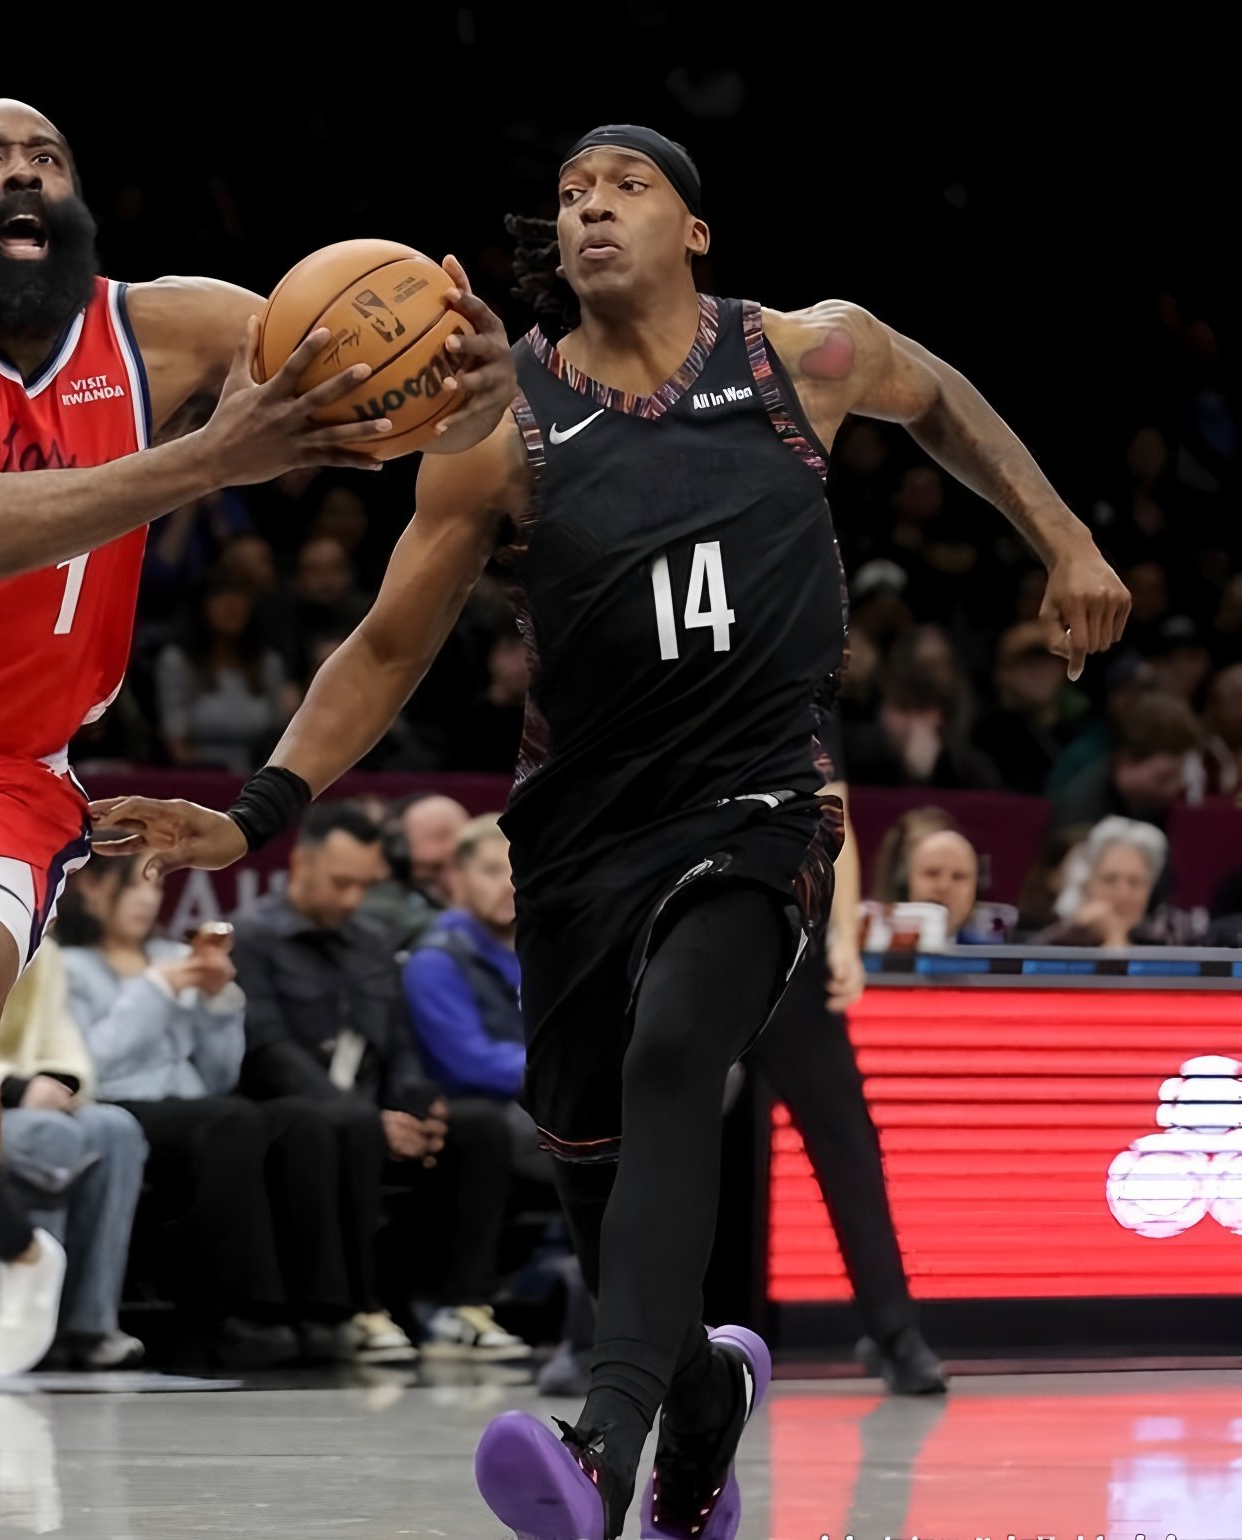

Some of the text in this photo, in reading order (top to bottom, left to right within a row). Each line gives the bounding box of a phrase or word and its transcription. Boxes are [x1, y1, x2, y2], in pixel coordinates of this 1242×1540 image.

[70, 374, 107, 391] VISIT
[61, 385, 125, 406] RWANDA
[692, 386, 753, 410] All In Won
[651, 540, 736, 661] 14
